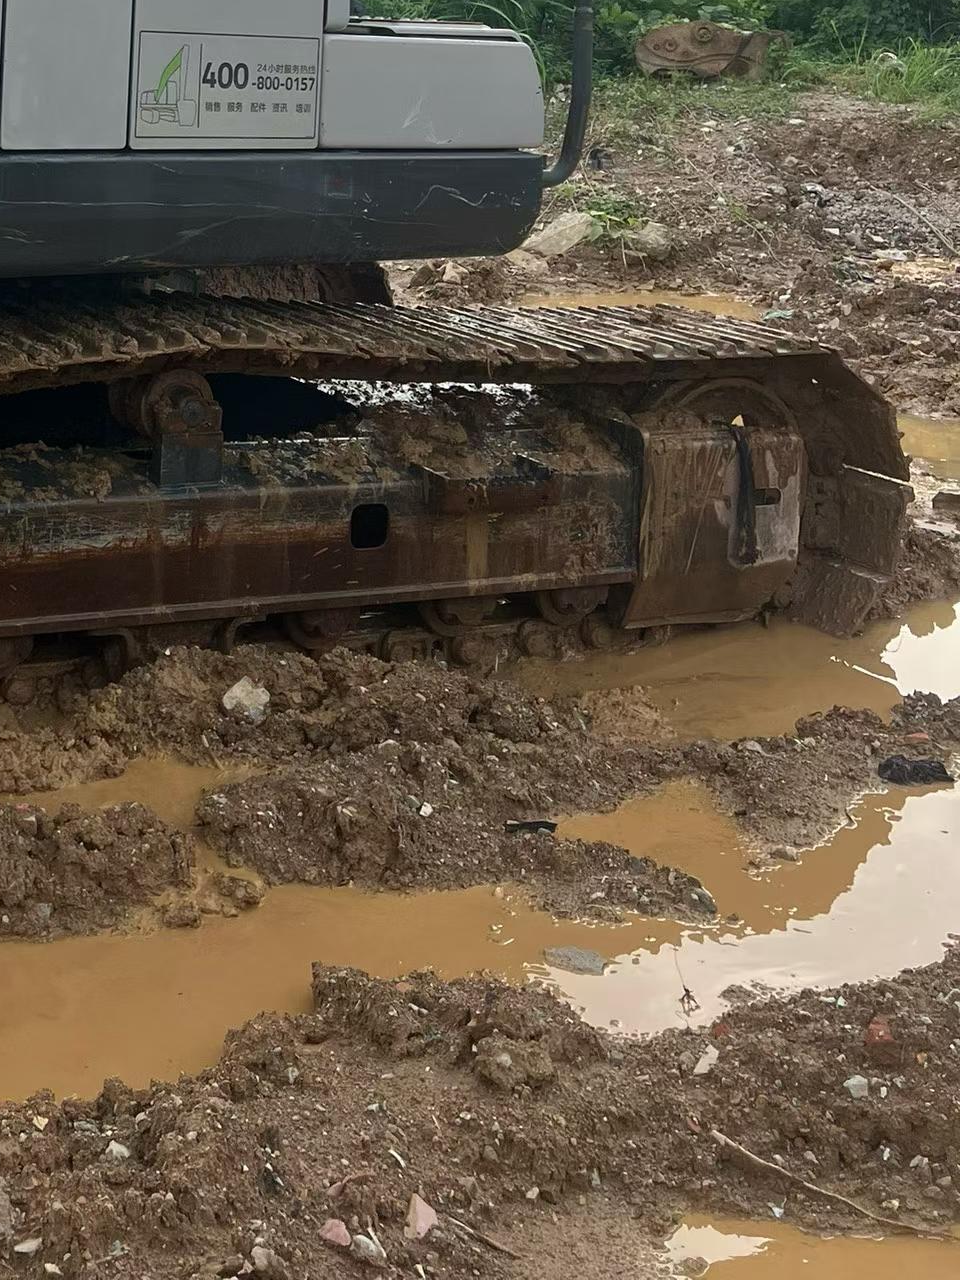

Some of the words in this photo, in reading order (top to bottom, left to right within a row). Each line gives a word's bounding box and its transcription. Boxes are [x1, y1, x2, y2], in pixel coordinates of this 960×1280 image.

[202, 62, 249, 90] 400
[227, 102, 243, 113] 服务
[250, 102, 266, 113] 配件
